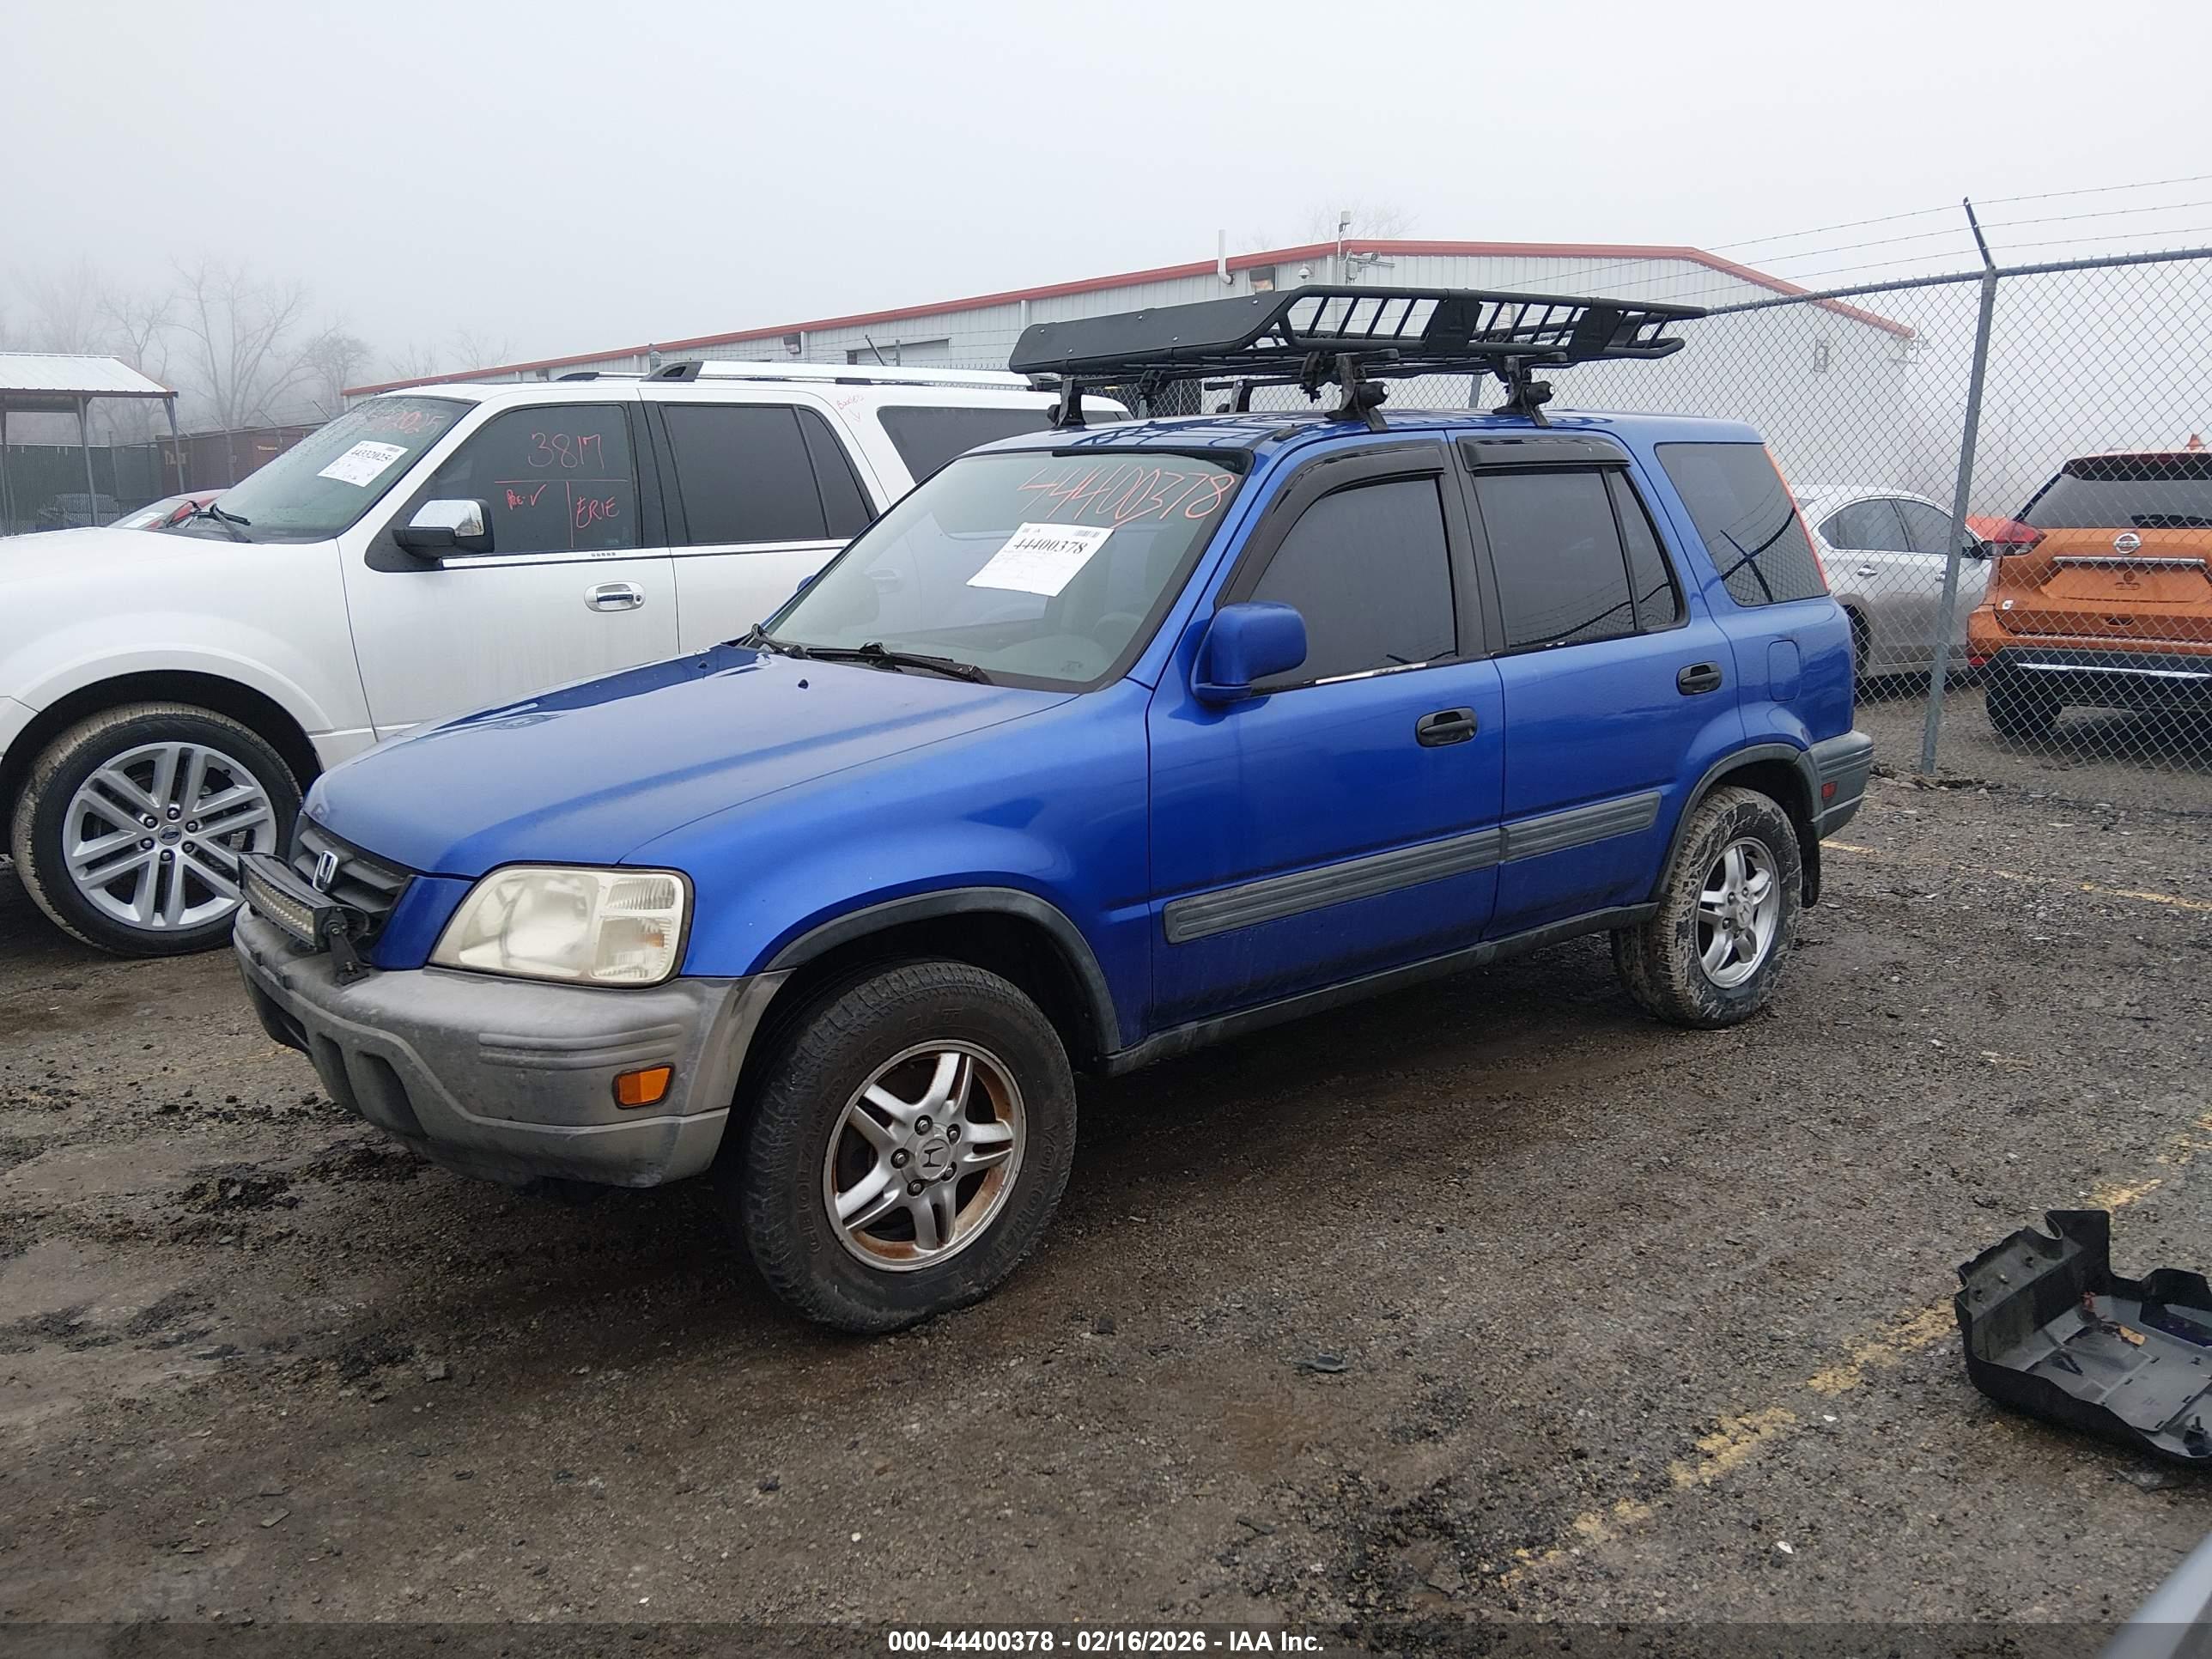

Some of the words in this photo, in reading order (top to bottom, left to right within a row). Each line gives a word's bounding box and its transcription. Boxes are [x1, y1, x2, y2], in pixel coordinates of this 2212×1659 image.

[528, 433, 605, 470] 3817
[576, 496, 619, 529] ERIE
[1017, 464, 1236, 529] 44400378
[1013, 538, 1088, 555] 44400378
